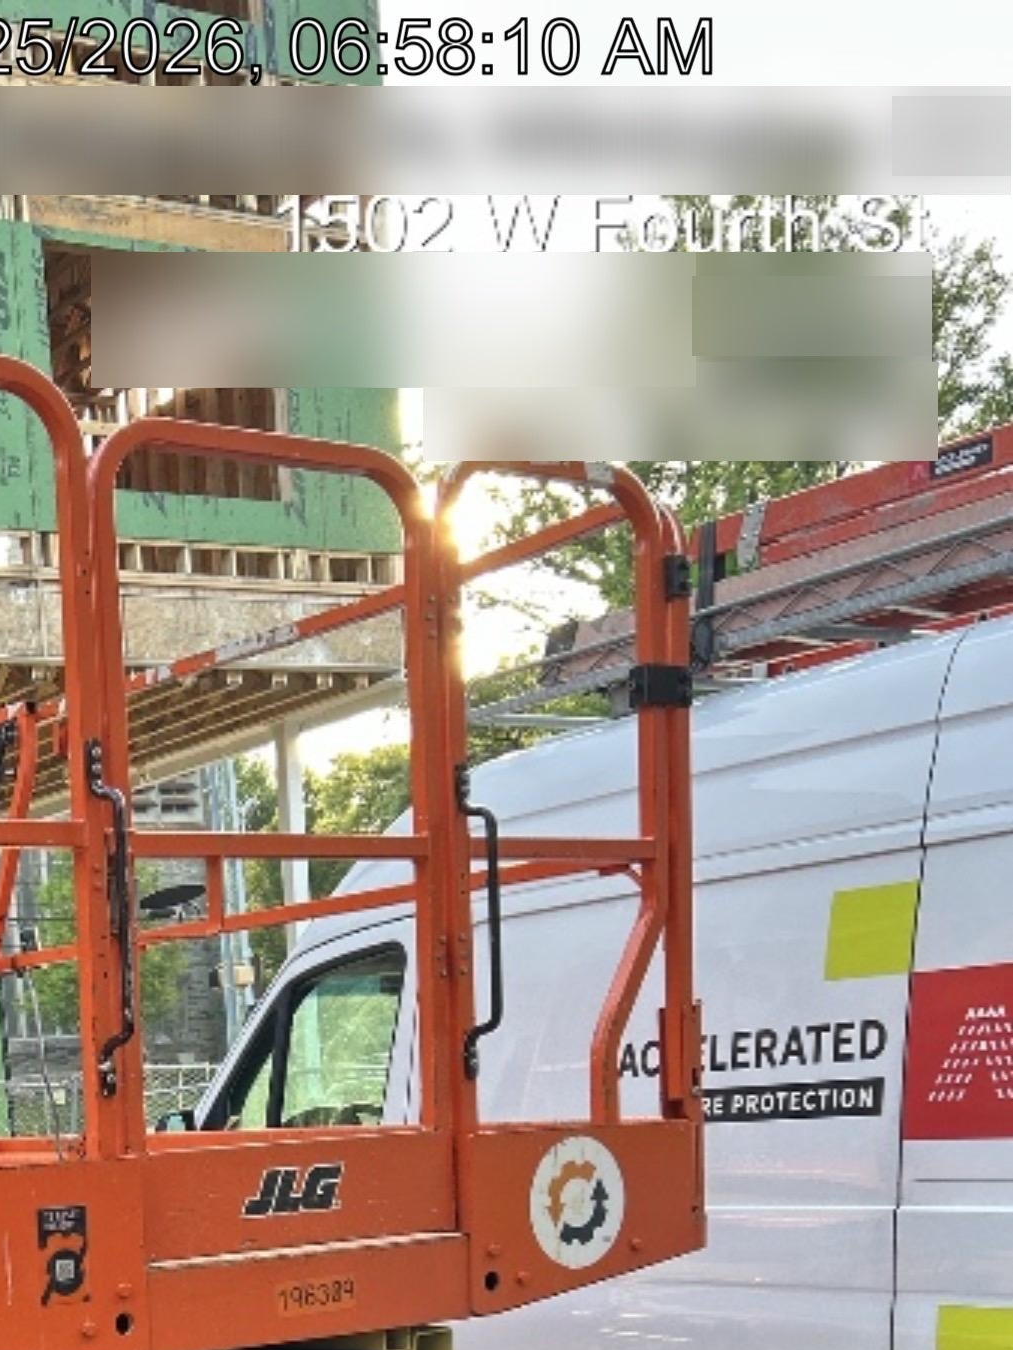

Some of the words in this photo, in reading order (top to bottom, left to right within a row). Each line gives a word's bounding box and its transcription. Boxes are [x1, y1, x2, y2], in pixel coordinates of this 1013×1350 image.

[618, 1019, 889, 1079] ACLERATED
[731, 1086, 875, 1114] PROTECTION
[241, 1162, 343, 1218] JLG
